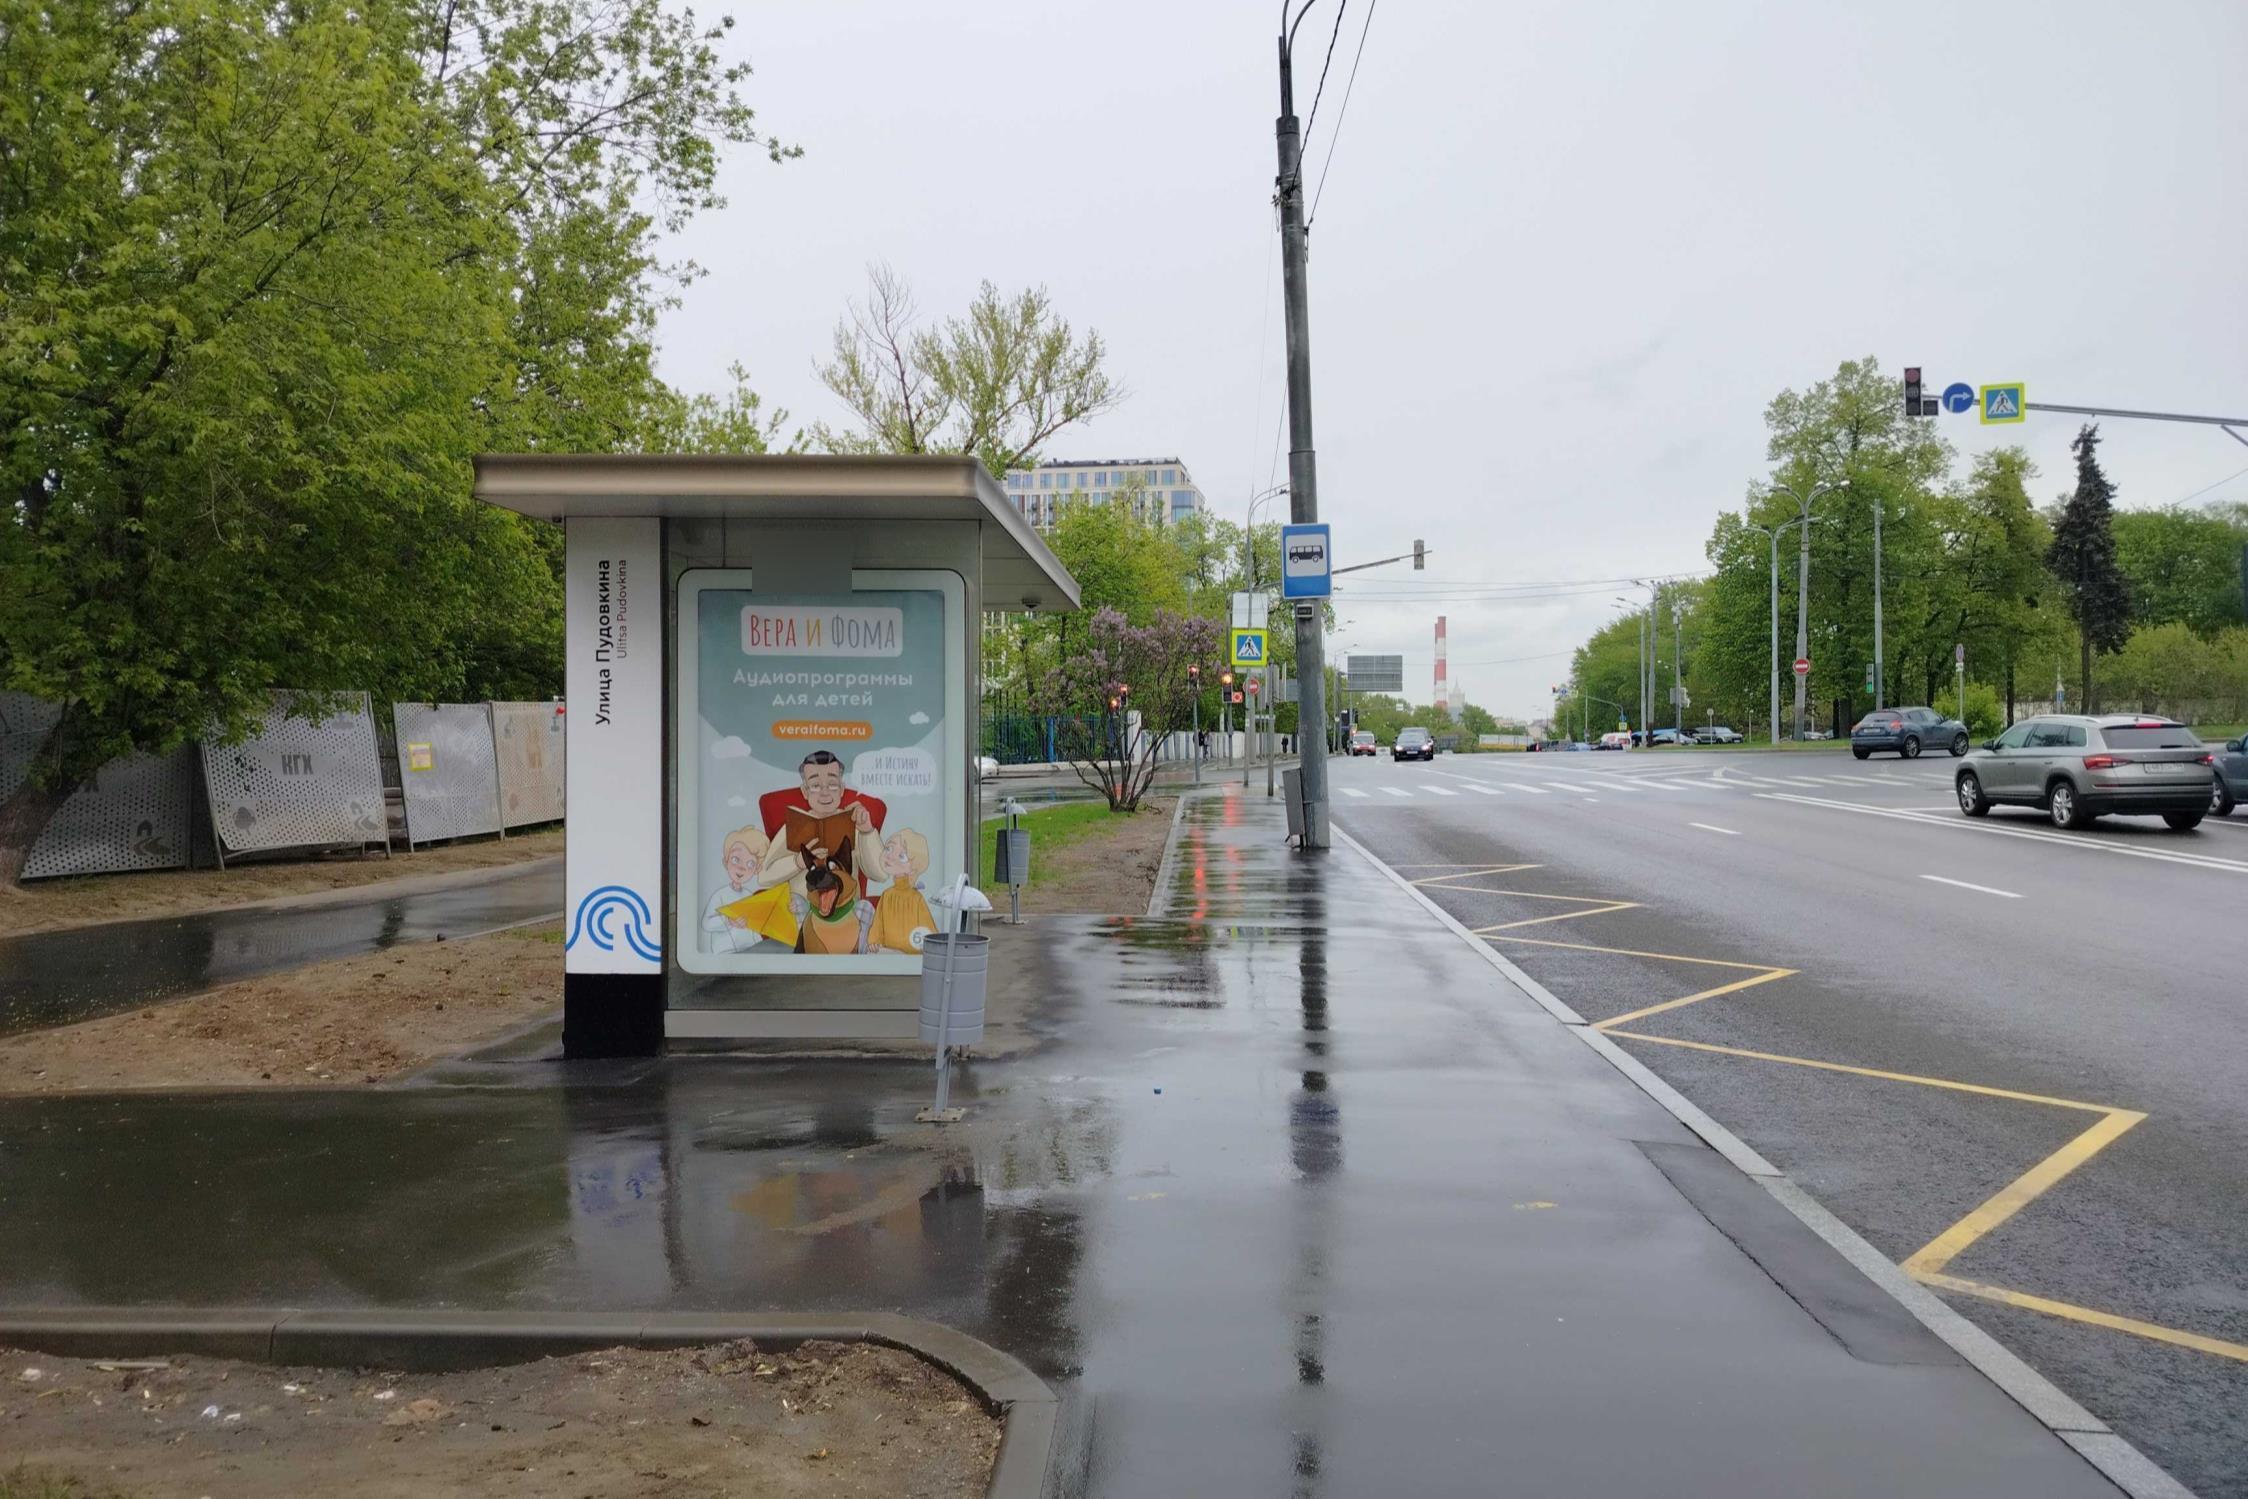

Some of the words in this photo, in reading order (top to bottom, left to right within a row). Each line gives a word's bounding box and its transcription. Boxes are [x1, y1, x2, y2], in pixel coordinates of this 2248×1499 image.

[616, 559, 627, 622] Pudovkina
[595, 560, 614, 662] Пудовкина
[616, 625, 627, 659] Ulitsa
[750, 614, 797, 648] ВЕРА
[806, 617, 822, 648] И
[831, 613, 896, 650] ФОМА
[732, 668, 913, 689] Аудиопрограммы
[595, 668, 612, 725] Улица
[772, 694, 808, 708] для
[815, 691, 873, 708] детей
[779, 723, 866, 737] veraifoma.ru
[281, 754, 314, 775] КГХ
[861, 773, 893, 787] ВМЕСТЕ
[912, 931, 922, 945] 6
